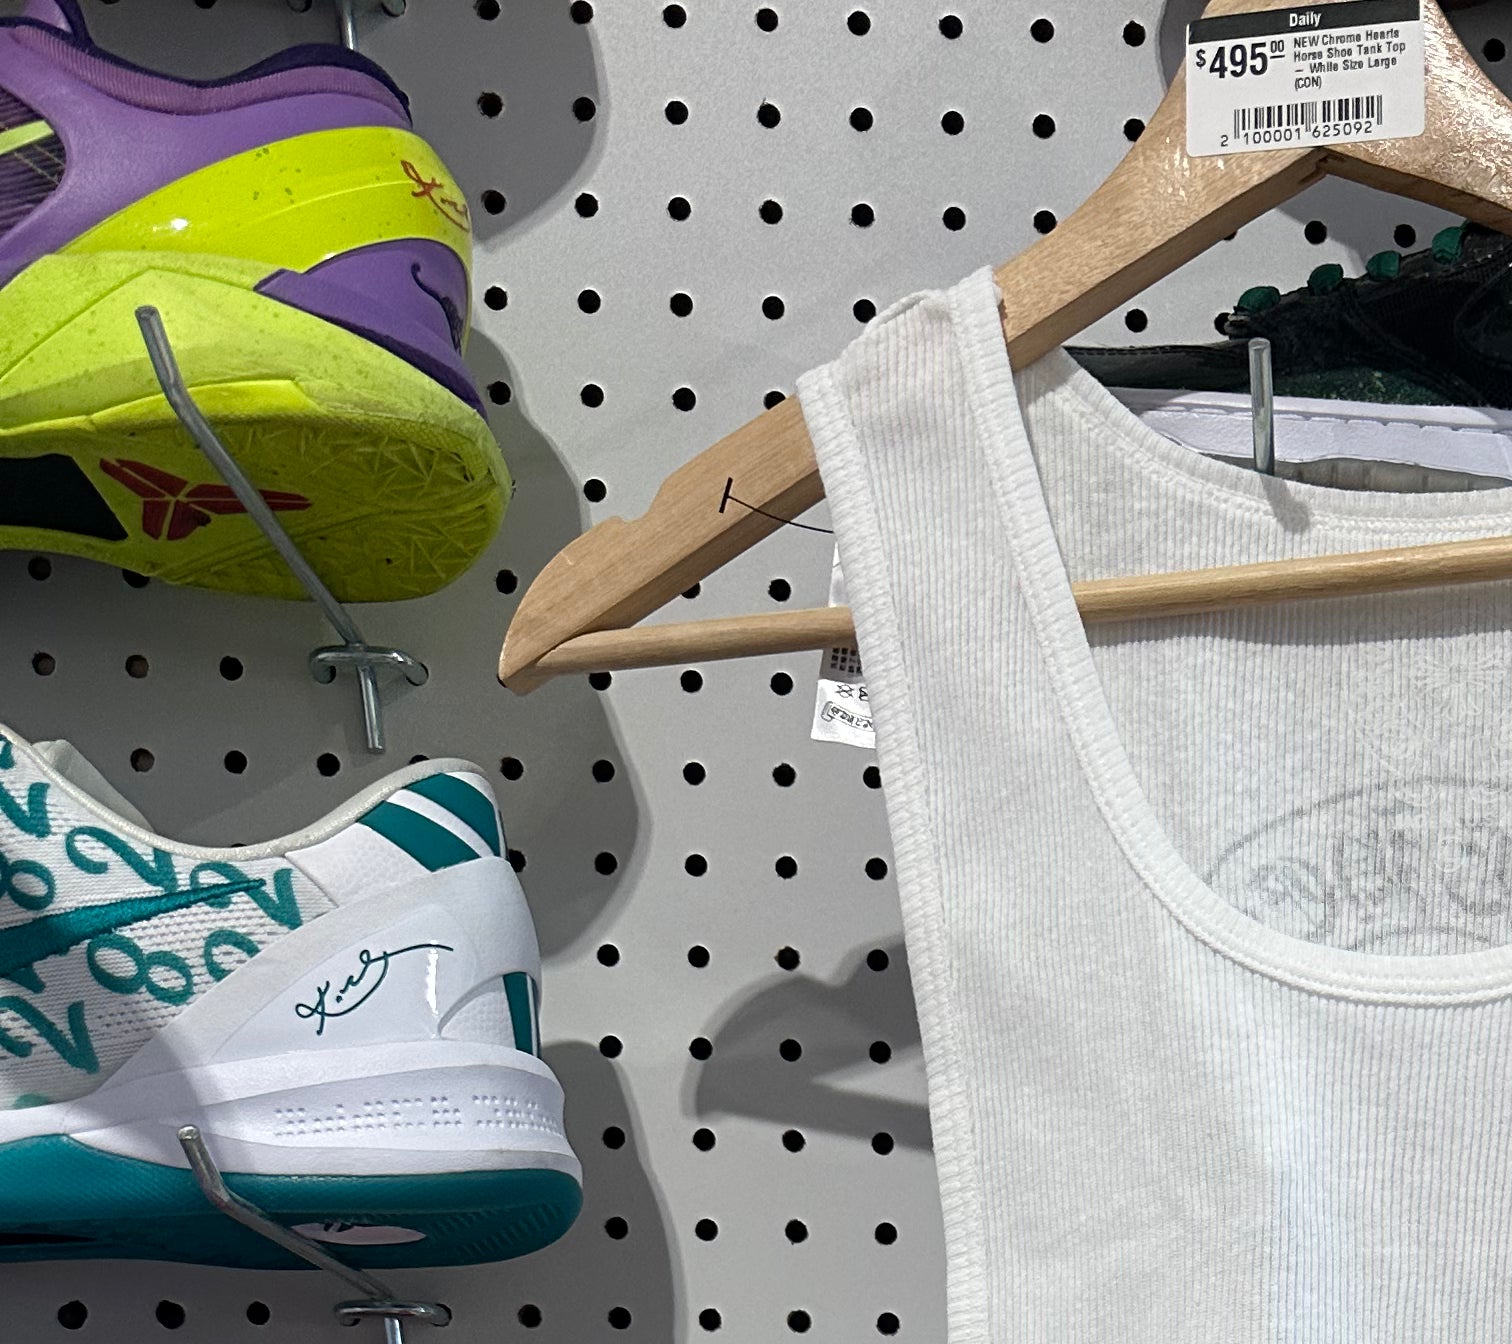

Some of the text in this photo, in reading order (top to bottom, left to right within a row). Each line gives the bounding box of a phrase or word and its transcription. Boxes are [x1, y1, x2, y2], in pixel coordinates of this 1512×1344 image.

[1289, 12, 1322, 27] Daily
[1293, 28, 1400, 49] NEW Chrome Hearts
[1293, 41, 1406, 62] Horse Shoe Tank Top
[1309, 62, 1339, 74] White
[1343, 59, 1363, 71] Size
[1368, 56, 1397, 70] Large
[1294, 75, 1322, 91] (CON)
[1244, 127, 1302, 145] 100001
[1312, 120, 1373, 139] 625092
